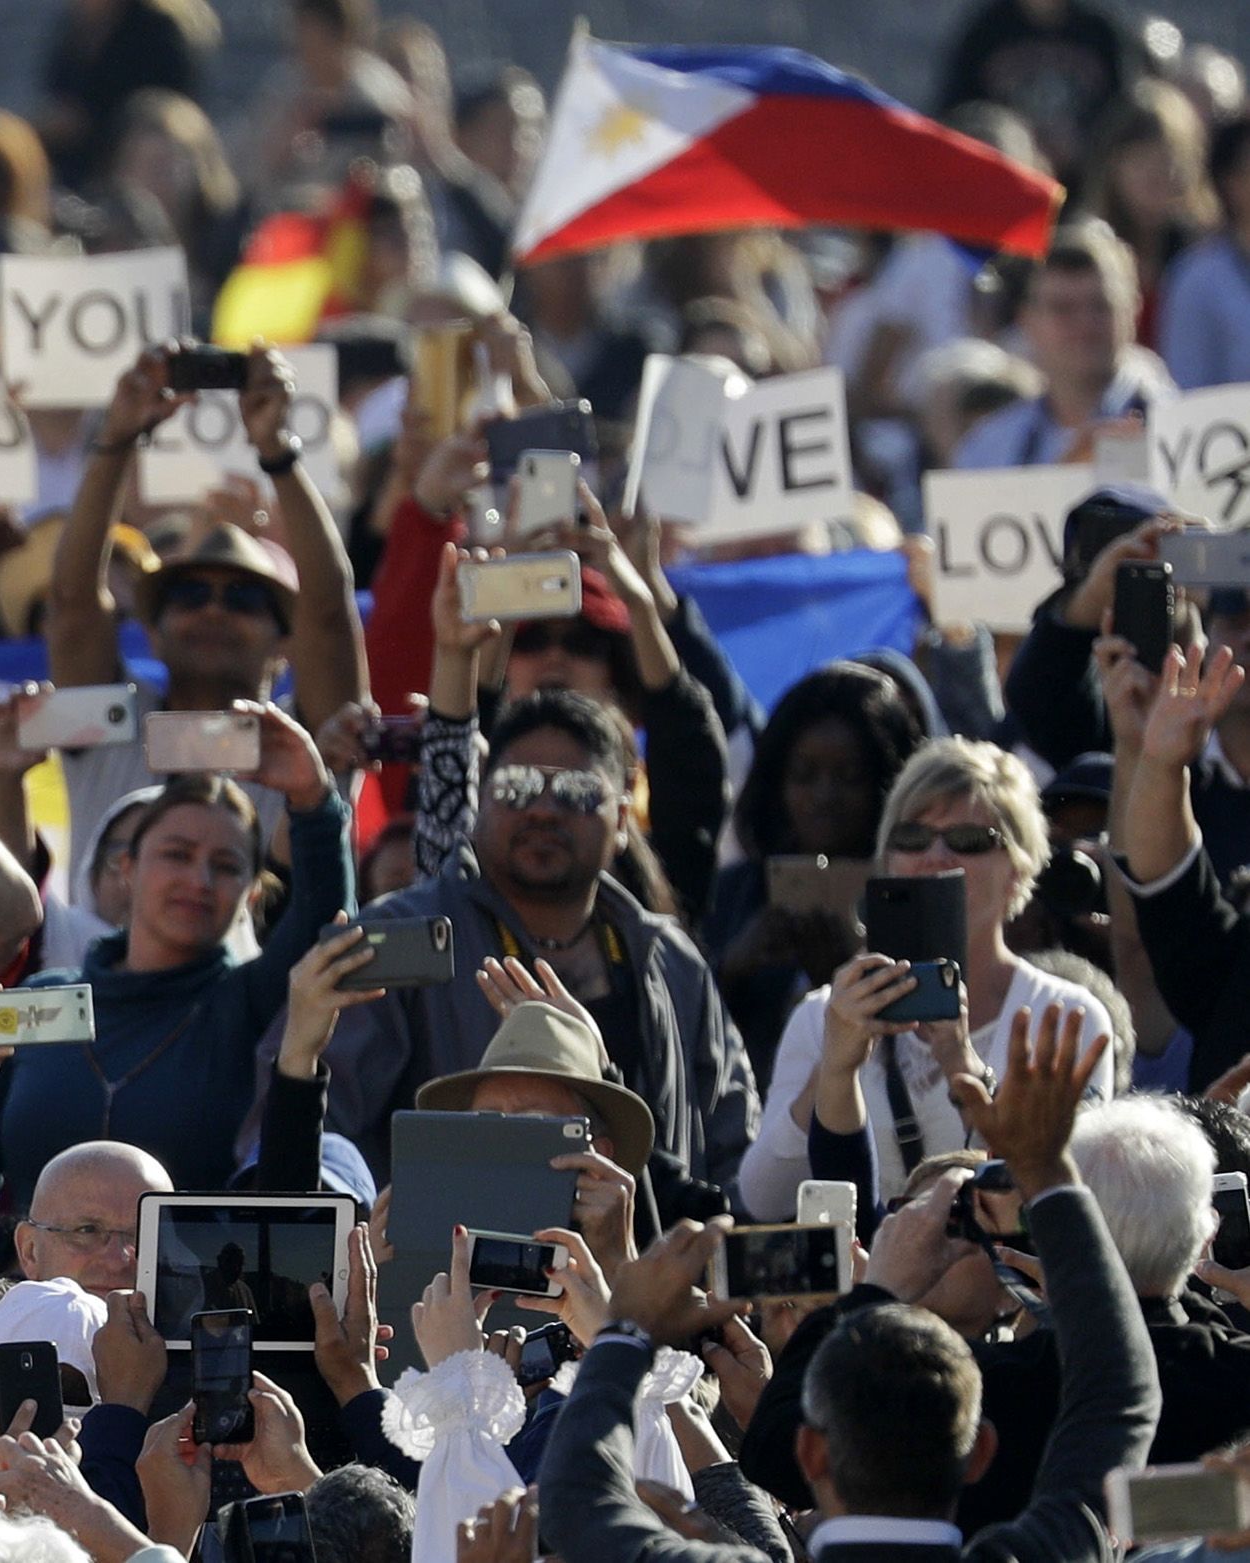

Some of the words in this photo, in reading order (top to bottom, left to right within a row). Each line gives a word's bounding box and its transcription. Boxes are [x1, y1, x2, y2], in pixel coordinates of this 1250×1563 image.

[11, 284, 190, 358] YOU
[720, 405, 839, 499] VE
[1157, 419, 1248, 488] YO
[936, 514, 1064, 578] LOV
